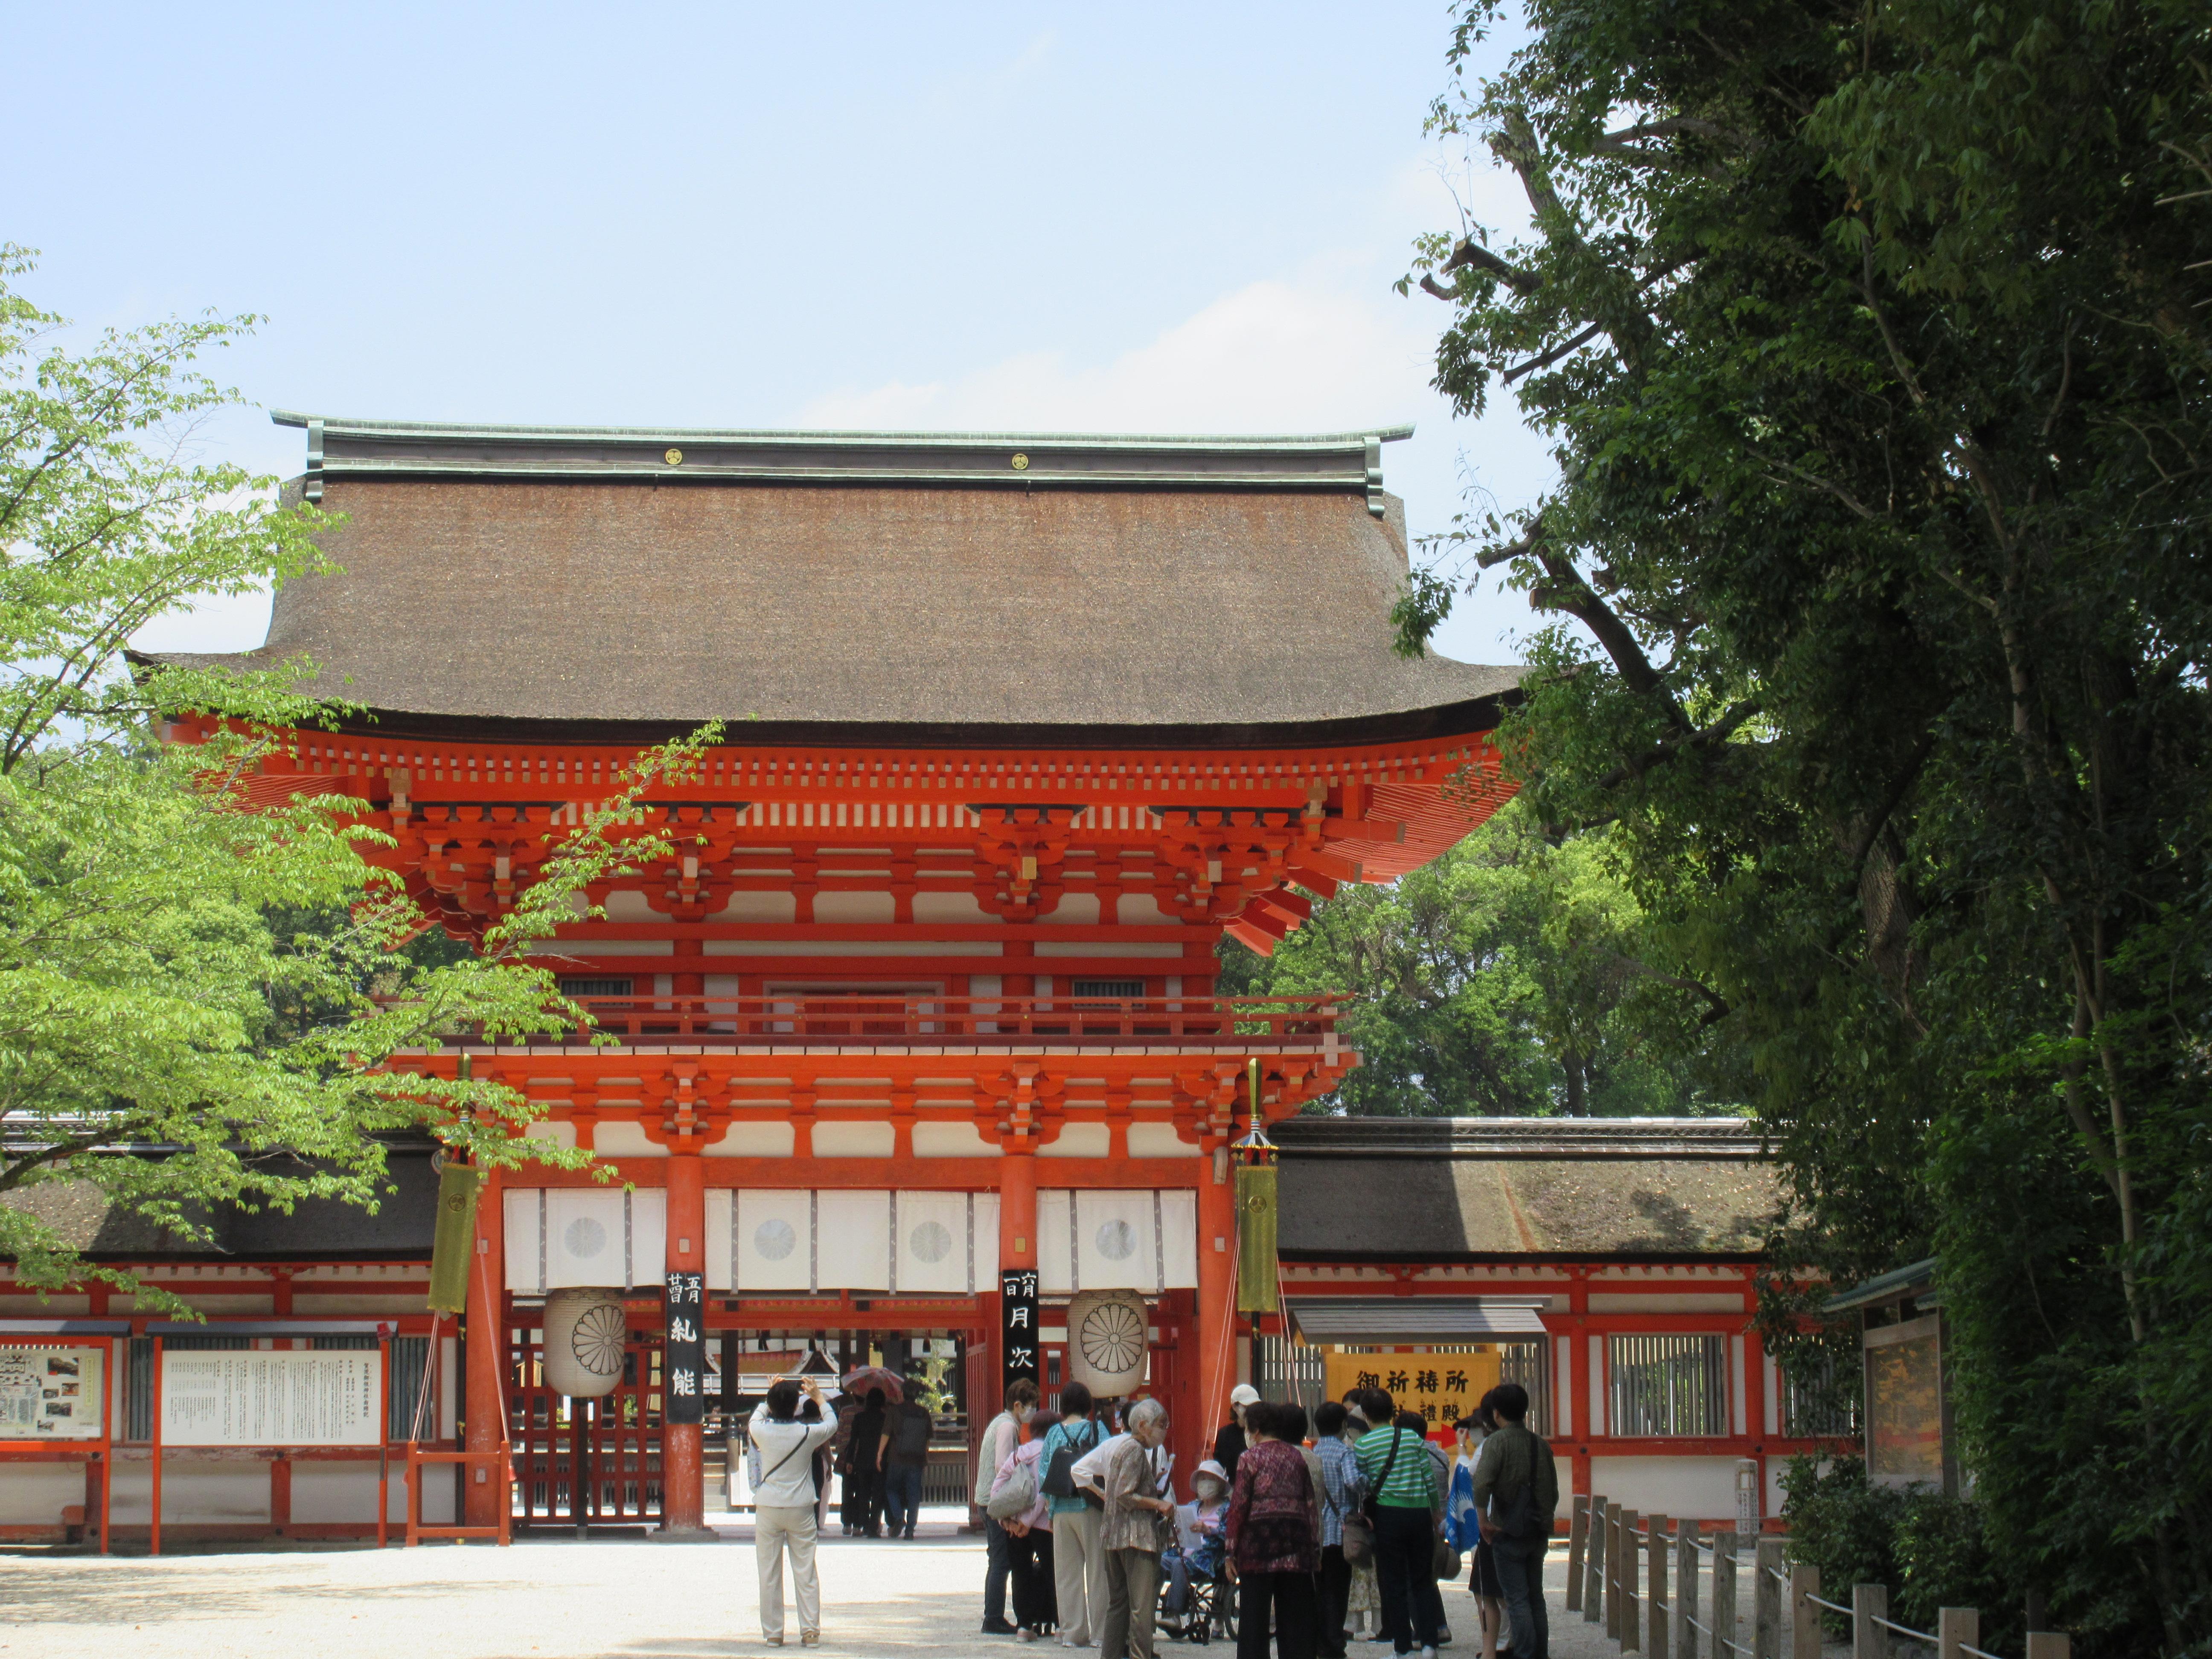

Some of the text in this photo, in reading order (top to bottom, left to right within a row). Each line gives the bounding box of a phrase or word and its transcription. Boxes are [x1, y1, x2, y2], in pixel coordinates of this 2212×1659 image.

[667, 1273, 683, 1304] 廿四日
[684, 1276, 701, 1304] 五月
[1003, 1278, 1020, 1296] 一日
[1021, 1272, 1037, 1298] 六月
[671, 1316, 697, 1396] 糺能
